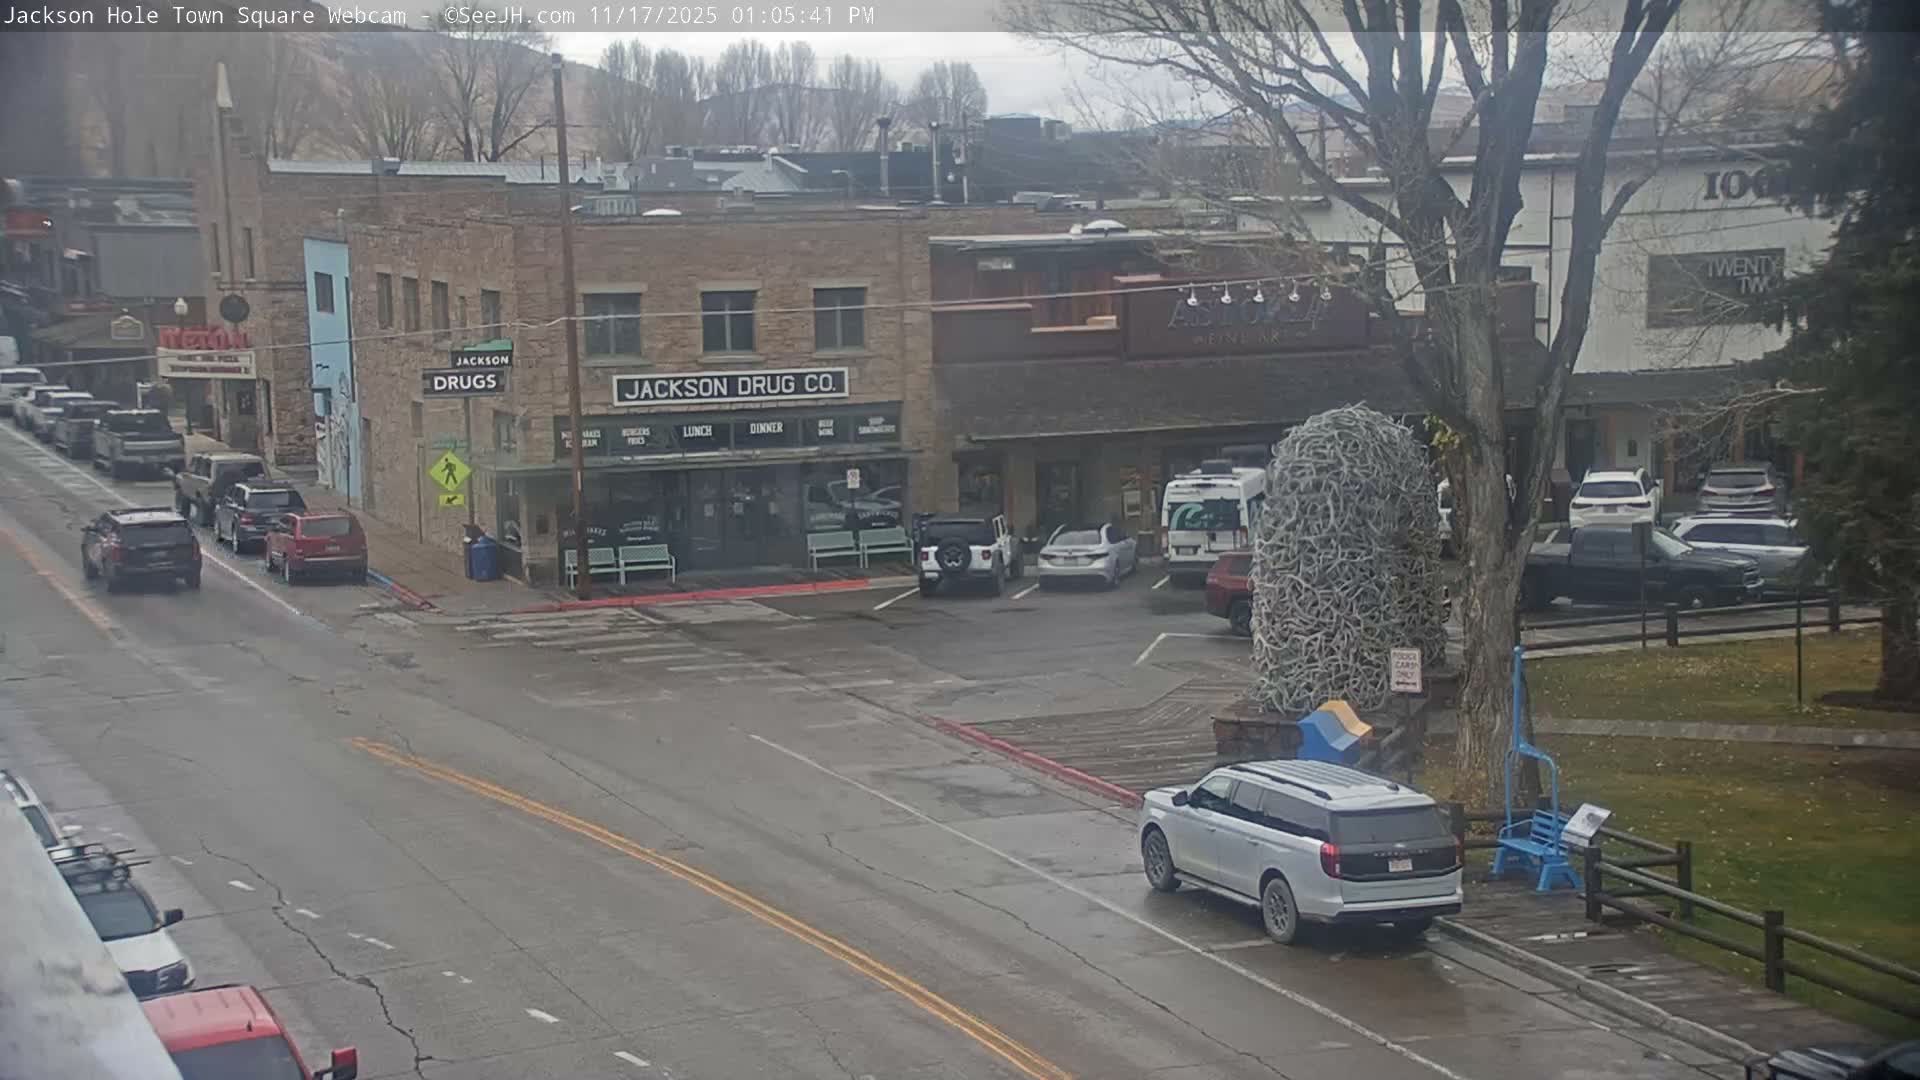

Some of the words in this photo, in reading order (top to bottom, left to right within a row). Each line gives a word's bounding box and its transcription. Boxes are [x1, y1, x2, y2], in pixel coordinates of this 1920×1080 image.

[455, 355, 509, 367] JACKSON
[433, 373, 497, 391] DRUGS
[625, 379, 728, 399] JACKSON
[737, 375, 796, 396] DRUG
[804, 374, 836, 393] CO.
[683, 424, 713, 438] LUNCH
[750, 422, 784, 435] DINNER
